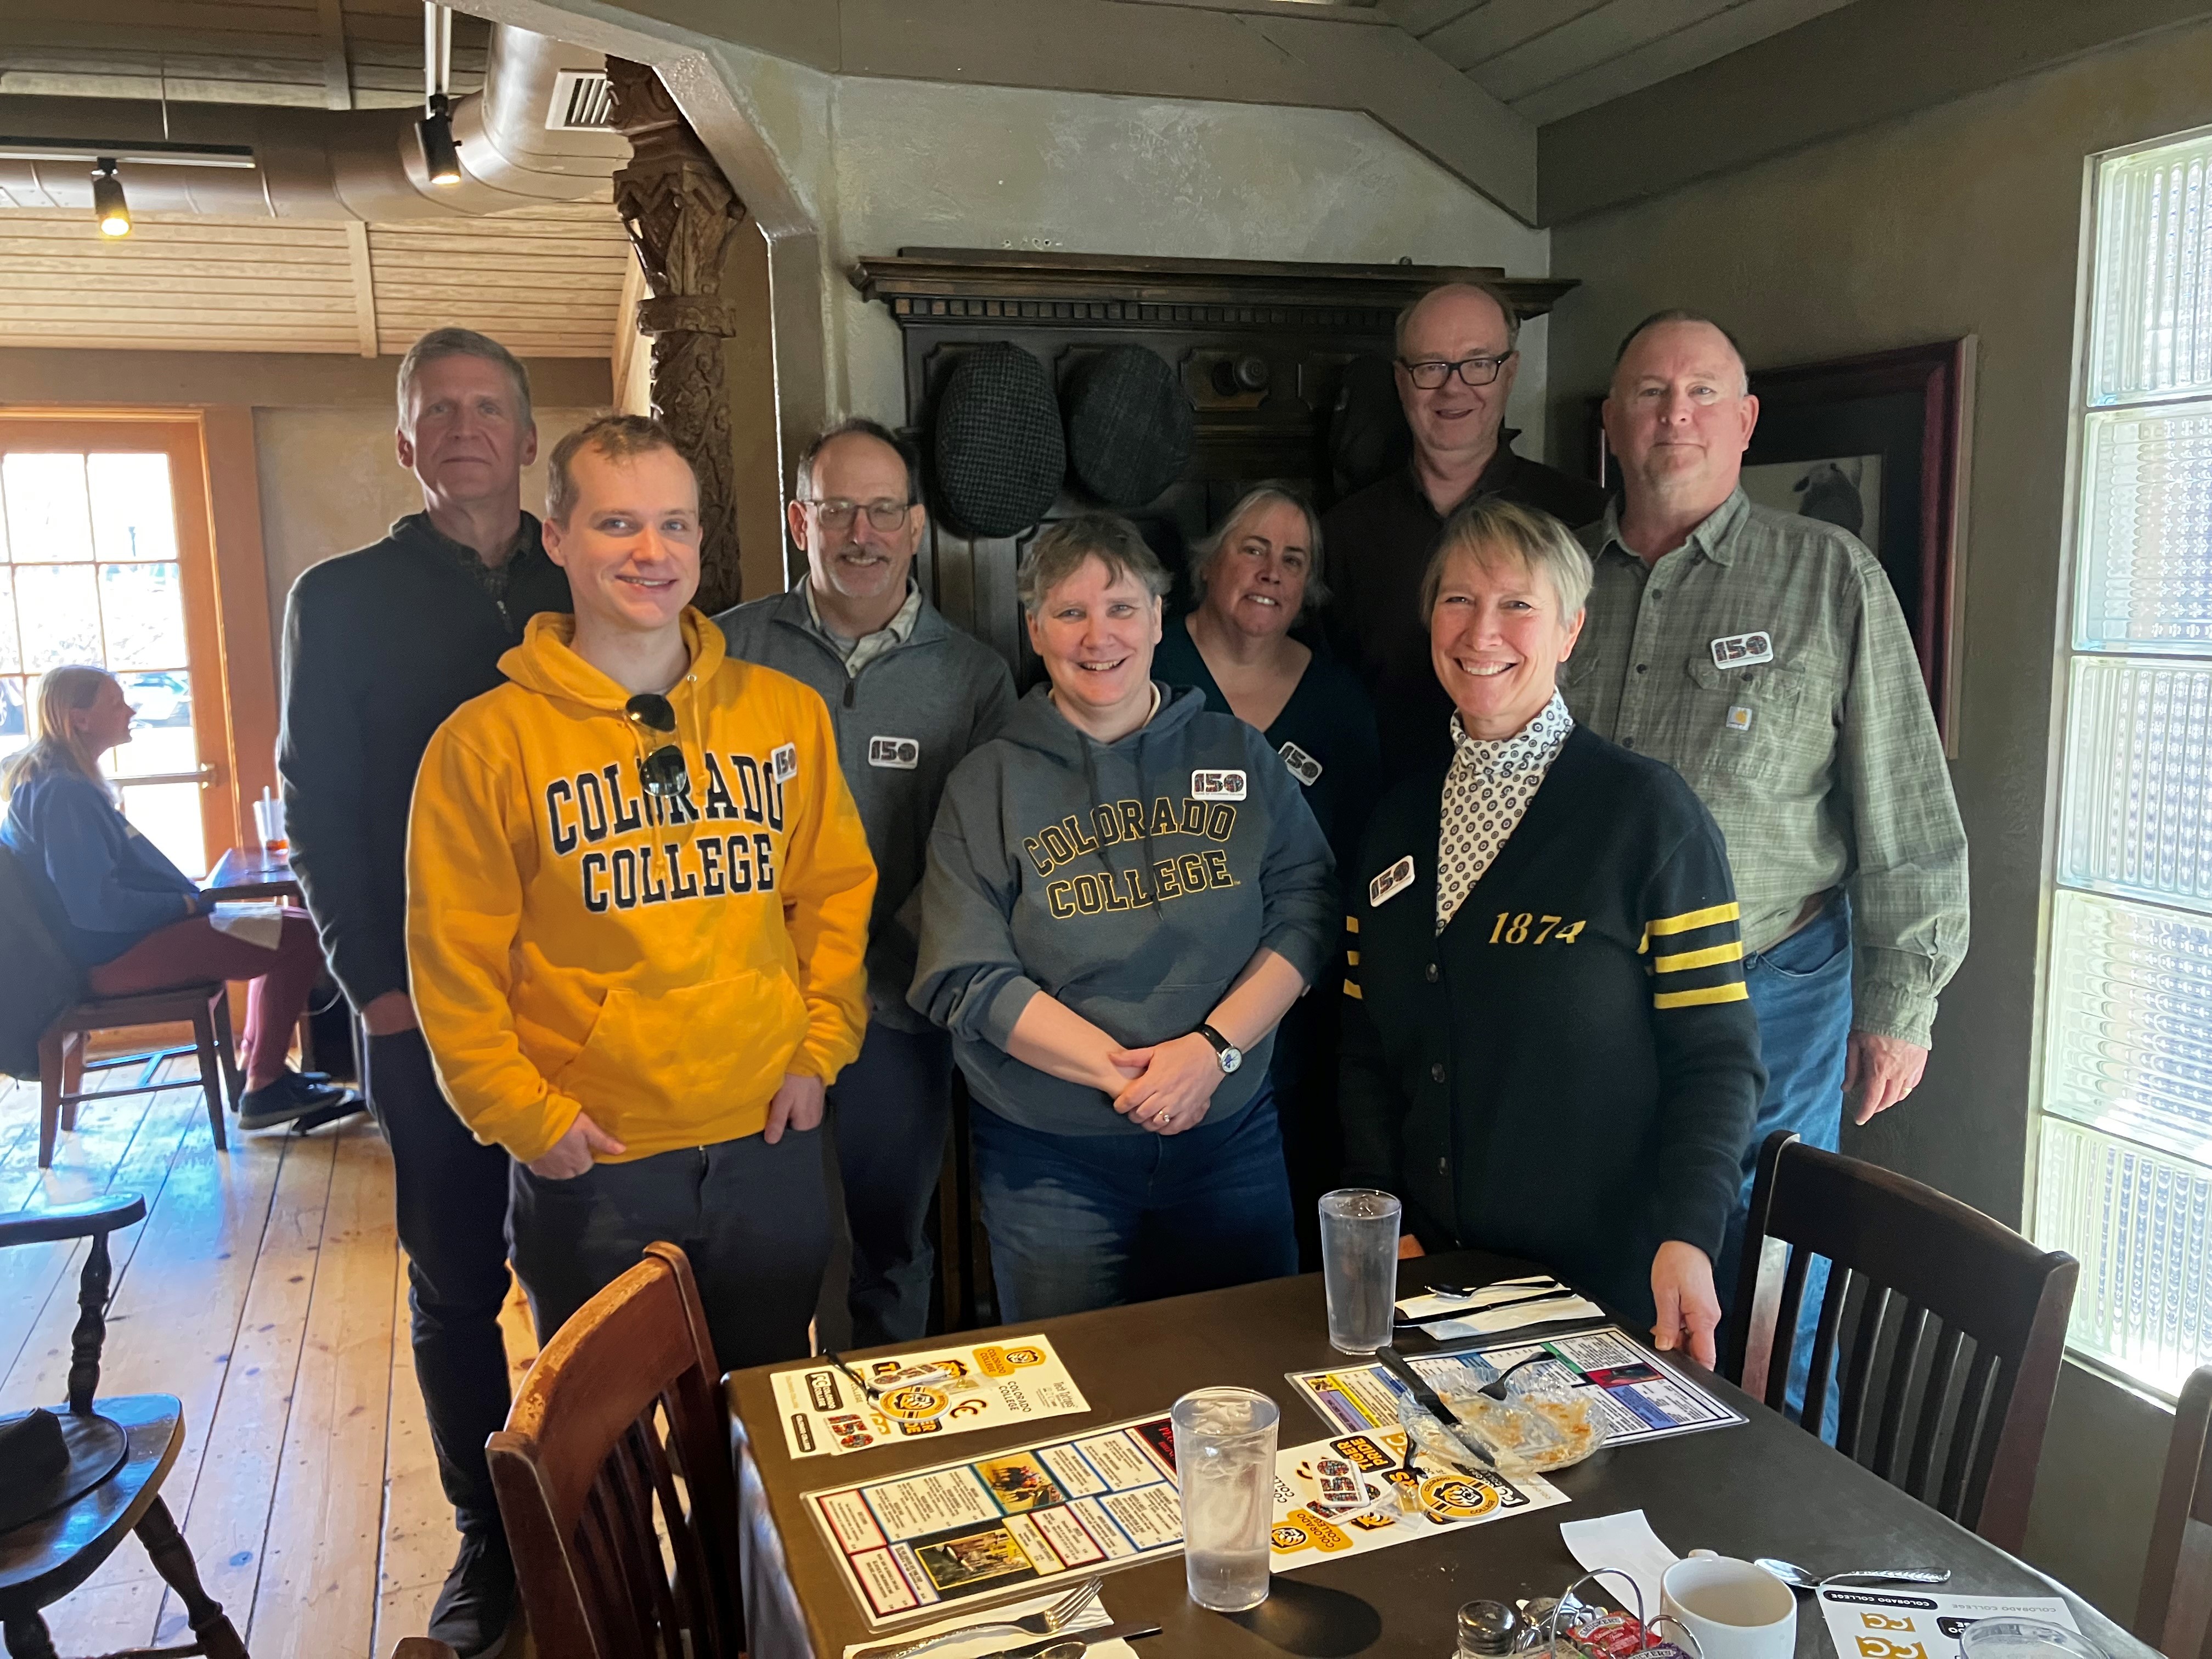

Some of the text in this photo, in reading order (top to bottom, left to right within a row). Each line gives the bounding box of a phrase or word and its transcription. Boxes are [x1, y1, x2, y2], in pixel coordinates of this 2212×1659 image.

[1715, 636, 1768, 661] 150
[776, 748, 795, 775] 150
[871, 741, 916, 761] 150
[1194, 774, 1244, 792] 150
[1023, 797, 1236, 877] COLORADO
[582, 832, 775, 913] COLLEGE
[1046, 849, 1234, 919] COLLEGE
[1371, 861, 1409, 900] 150
[1488, 912, 1587, 944] 1874
[980, 1352, 996, 1373] COLLEGE
[998, 1385, 1020, 1411] COLLEGE
[1007, 1381, 1032, 1412] COLORADO
[1337, 1441, 1373, 1471] TIGER
[1350, 1437, 1389, 1466] PRIDE
[1297, 1513, 1335, 1548] COLORADO
[1309, 1515, 1341, 1542] COLLEGE
[1831, 1593, 1930, 1606] COLORADO COLLEGE
